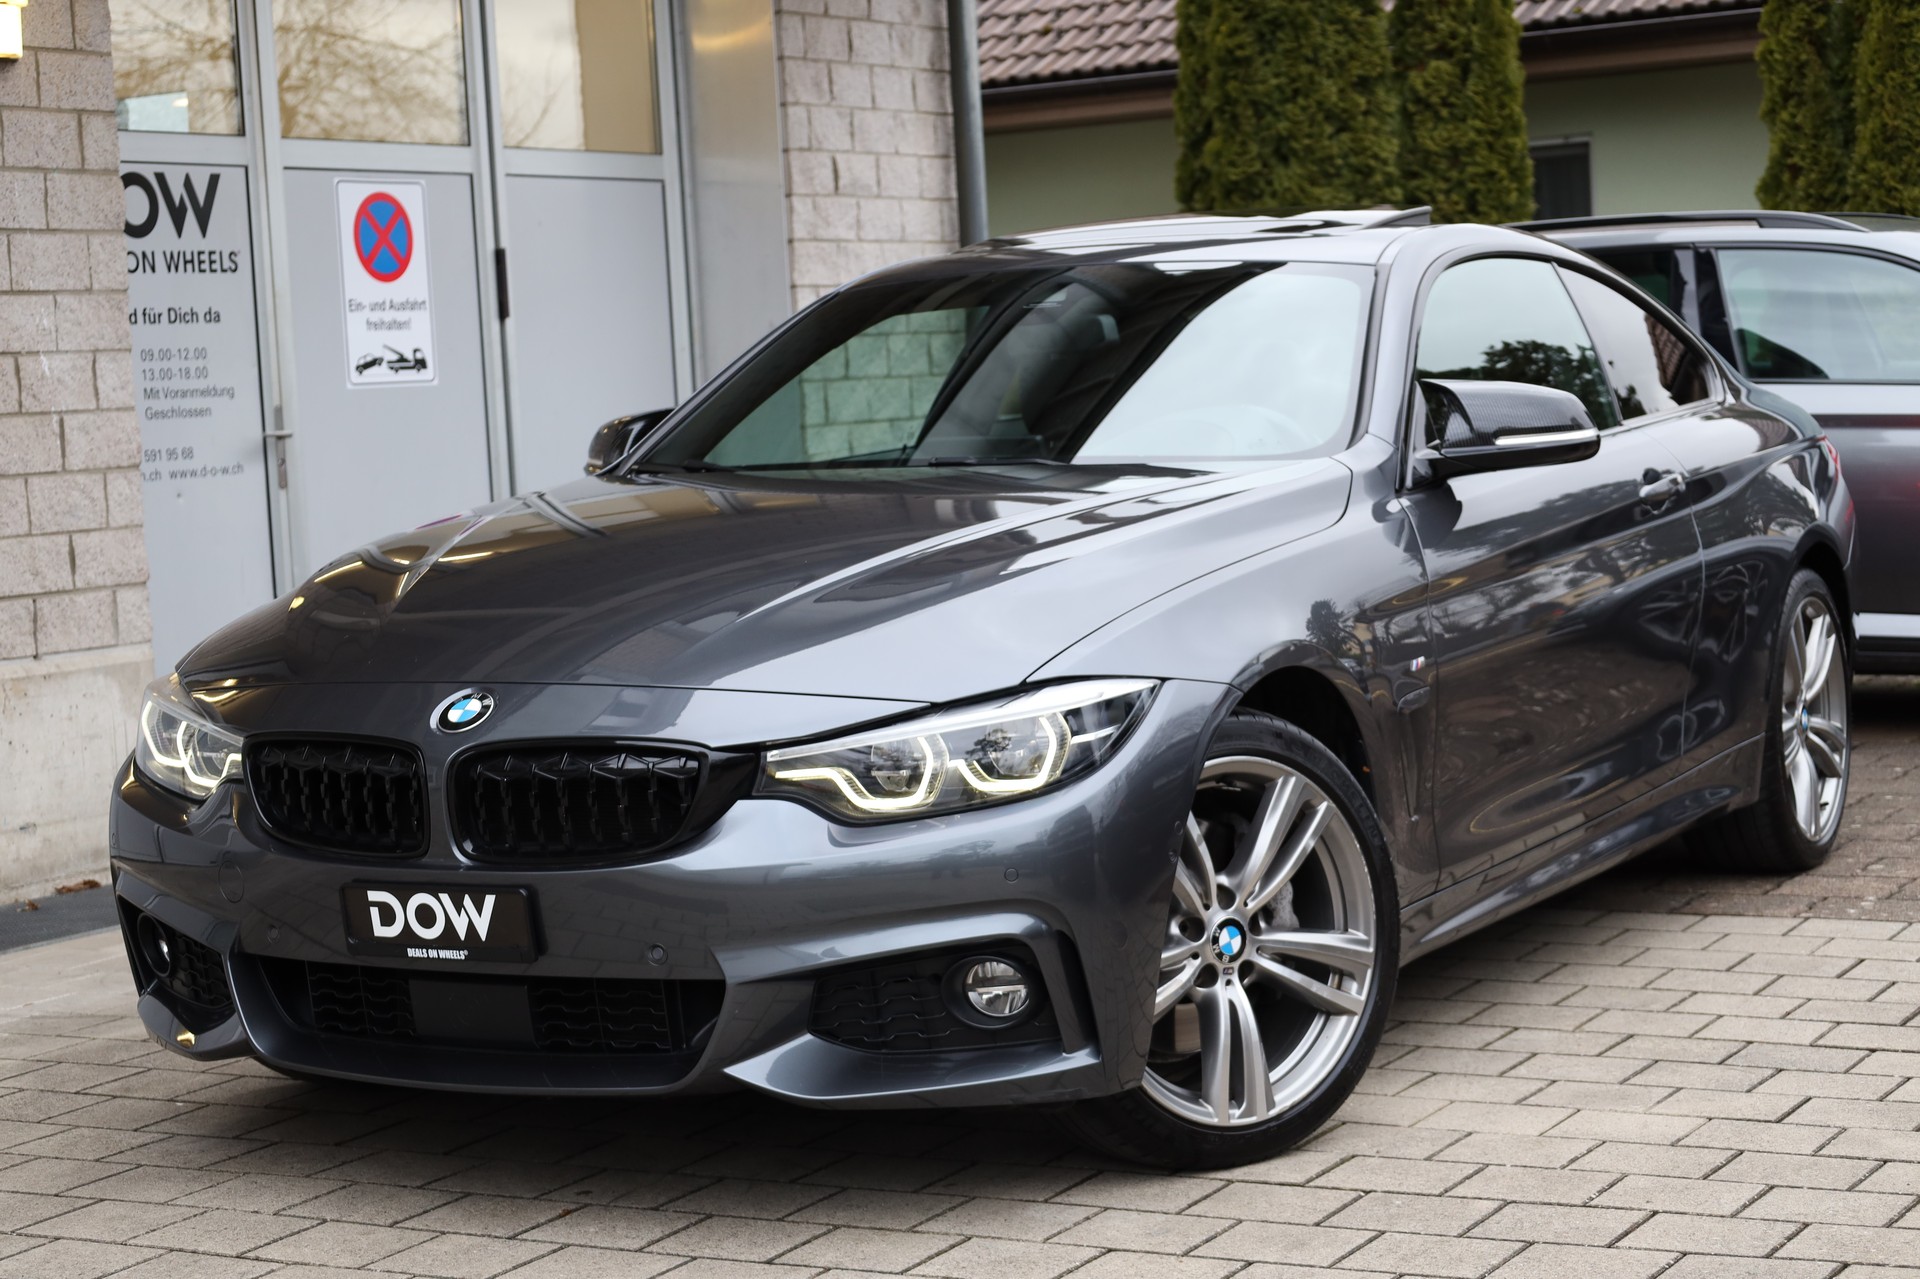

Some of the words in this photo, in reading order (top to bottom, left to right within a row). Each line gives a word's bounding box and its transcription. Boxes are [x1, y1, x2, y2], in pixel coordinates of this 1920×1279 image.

[127, 250, 156, 274] ON
[163, 250, 239, 274] WHEELS
[369, 298, 386, 312] und
[388, 297, 427, 312] Ausfahrt
[142, 307, 162, 325] für
[167, 306, 199, 324] Dich
[203, 306, 221, 323] da
[140, 347, 208, 362] 09.00-12.00
[142, 366, 208, 381] 13.00-18.00
[143, 387, 161, 400] Mit
[162, 384, 235, 400] Voranmeldung
[144, 406, 212, 420] Geschlossen
[165, 447, 179, 461] 95
[181, 446, 194, 460] 68
[168, 462, 244, 480] www.d-o-w.ch
[367, 890, 496, 942] DOW
[407, 947, 428, 958] DEALS
[428, 948, 438, 959] ON
